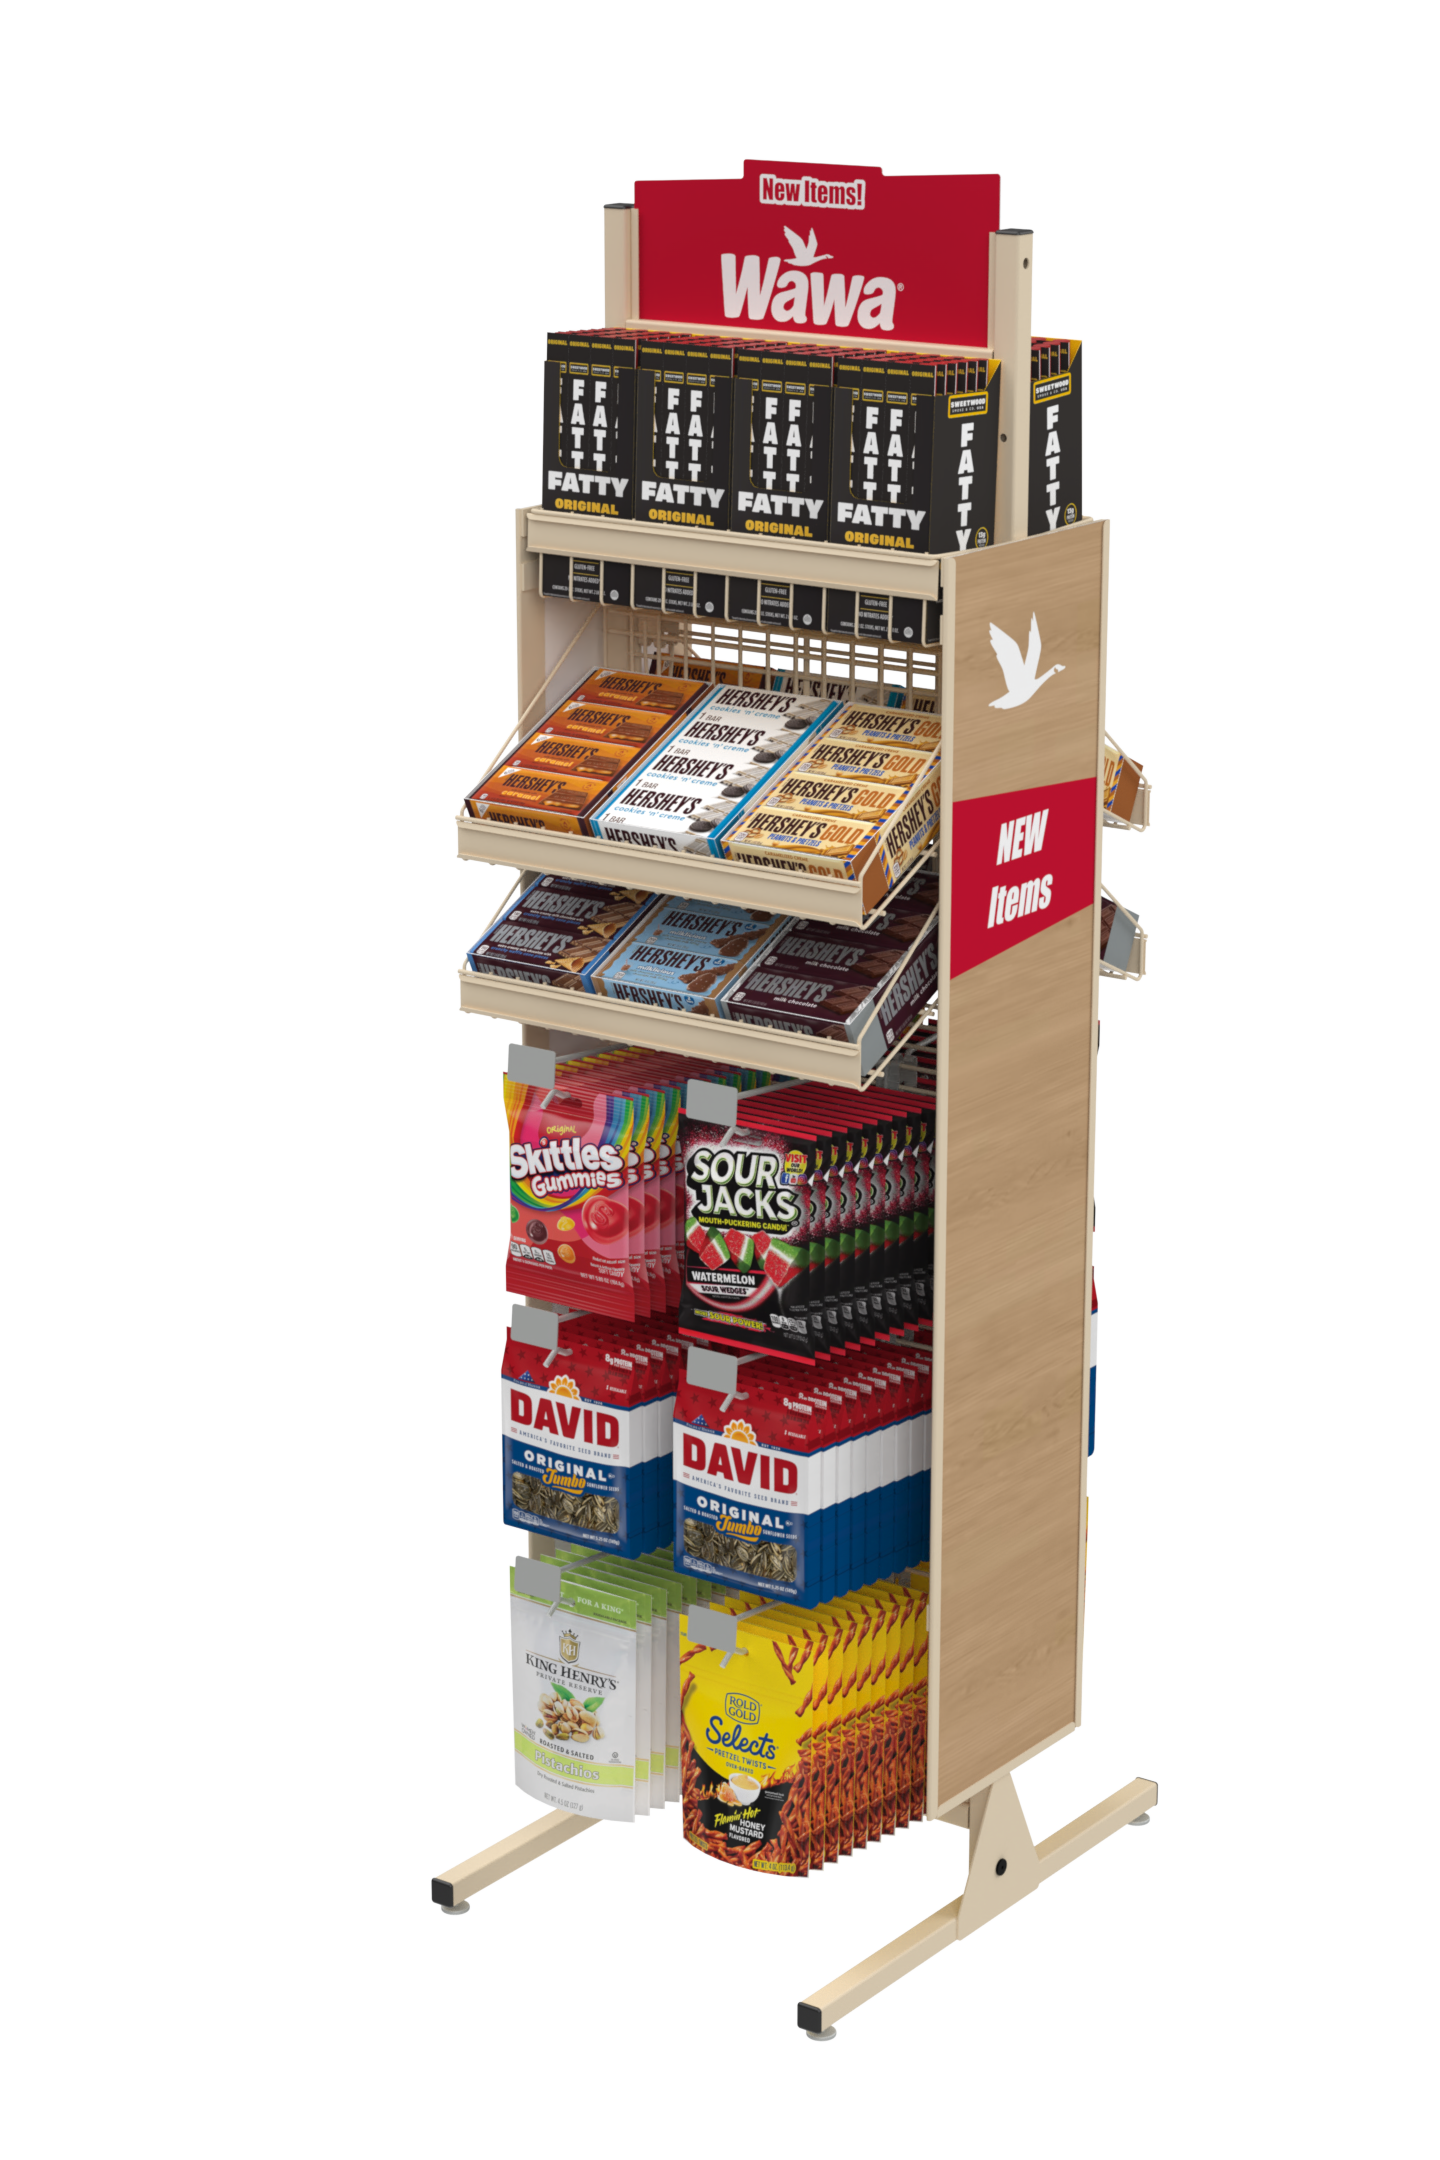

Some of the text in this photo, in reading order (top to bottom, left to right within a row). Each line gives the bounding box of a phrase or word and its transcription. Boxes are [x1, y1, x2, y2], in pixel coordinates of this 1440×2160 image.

[762, 177, 863, 206] New Items!
[720, 253, 897, 331] Wawa
[1036, 379, 1069, 394] SWEETWOOD
[951, 398, 986, 408] SWEETWOOD
[1045, 404, 1061, 531] FATTY
[548, 470, 629, 497] FATTY
[956, 422, 974, 551] FATTY
[641, 480, 725, 508] FATTY
[555, 498, 618, 515] ORIGINAL
[737, 491, 824, 520] FATTY
[648, 509, 714, 526] ORIGINAL
[837, 502, 926, 531] FATTY
[745, 519, 812, 538] ORIGINAL
[845, 530, 914, 549] ORIGINAL
[574, 563, 595, 571] GLUTEN-FREE
[668, 575, 689, 583] GLUTEN-FREE
[765, 587, 787, 595] GLUTEN-FREE
[865, 599, 887, 607] GLUTEN-FREE
[599, 676, 662, 694] HERSHEY'S
[598, 691, 637, 702] caramel
[716, 688, 796, 713] HERSHEY'S
[567, 708, 631, 727] HERSHEY'S
[699, 712, 722, 722] 1 BAR
[710, 704, 780, 720] cookies creme
[566, 723, 605, 735] caramel
[684, 721, 765, 747] HERSHEY'S
[841, 710, 942, 739] HERSHEY'S GOL
[862, 730, 885, 738] PEANUTS
[535, 740, 599, 760] HERSHEY'S
[667, 745, 690, 756] 1 BAR
[679, 738, 750, 753] cookies creme
[534, 756, 574, 768] caramel
[652, 755, 734, 781] HERSHEY'S
[810, 744, 927, 774] HERSHEY'S GOLD
[647, 771, 718, 787] cookies creme
[831, 764, 885, 776] PEANUTS PRETZELS
[502, 773, 566, 792] HERSHEY'S
[641, 782, 658, 790] BAR
[501, 790, 540, 801] caramel
[620, 788, 702, 815] HERSHEY'S
[779, 778, 895, 809] HERSHEY'S GOLD
[614, 805, 685, 822] cookies creme
[799, 798, 853, 811] PEANUTS PRETZELS
[609, 816, 626, 824] BAR
[747, 813, 864, 844] HERSHEY'S GOLD
[887, 790, 933, 858] HERSHEY'S
[767, 833, 822, 847] PEANUTS PRETZELS
[996, 808, 1049, 866] NEW
[522, 890, 605, 919] HERSHEY'S
[987, 873, 1053, 929] Items
[662, 911, 742, 936] HERSHEY'S
[490, 924, 573, 953] HERSHEY'S
[630, 946, 710, 972] HERSHEY'S
[777, 936, 865, 967] HERSHEY'S
[637, 964, 675, 976] milklicious
[805, 960, 849, 972] milk chocolate
[744, 972, 833, 1002] HERSHEY'S
[880, 943, 938, 1026] HERSHEY'S
[613, 983, 682, 1010] HERSHEY'S
[794, 999, 817, 1008] chocolate
[511, 1137, 624, 1179] Skittles
[785, 1153, 808, 1163] VISIT
[691, 1150, 778, 1189] SOUR
[531, 1171, 624, 1197] Gummies
[698, 1184, 799, 1222] JACKS
[699, 1216, 761, 1229] MOUTH-PUCKERING
[692, 1271, 755, 1285] WATERMELON
[701, 1285, 719, 1293] SOUR
[710, 1312, 764, 1331] SOUR POWER!
[605, 1354, 632, 1368] 8g PROTEIN
[783, 1398, 812, 1412] 8g PROTEIN
[510, 1388, 619, 1448] DAVID
[520, 1430, 547, 1443] AMERICA'S
[550, 1439, 576, 1451] FAVORITE
[594, 1450, 611, 1458] BRAND
[512, 1459, 544, 1474] SALTED ROASTED
[524, 1450, 607, 1482] ORIGINAL
[683, 1432, 798, 1494] DAVID
[542, 1468, 586, 1489] Jumbo
[587, 1482, 608, 1490] SUNFLOWER
[692, 1475, 789, 1506] AMERICA'S FAVORITE SEED BRAND
[683, 1505, 718, 1520] SALTED ROASTED
[697, 1496, 784, 1529] ORIGINAL
[716, 1514, 762, 1536] Jumbo
[762, 1529, 785, 1538] SUNFLOWER
[577, 1597, 592, 1606] FOR
[601, 1605, 622, 1614] KING
[562, 1642, 576, 1656] KH
[526, 1653, 617, 1691] KING HENRY'S
[536, 1671, 602, 1695] PRIVATE RESERVE
[730, 1696, 757, 1711] ROLD
[729, 1707, 756, 1722] GOLD
[705, 1715, 775, 1759] Selects
[539, 1738, 564, 1753] ROASTED
[571, 1750, 594, 1760] SALTED
[714, 1748, 766, 1769] PRETZEL TWISTS
[535, 1750, 599, 1780] Pistachios
[726, 1762, 754, 1774] OVEN-BAKED
[544, 1773, 557, 1784] Roasted
[562, 1781, 574, 1790] Salted
[575, 1785, 594, 1793] Pistachios
[564, 1800, 569, 1808] OZ
[570, 1801, 578, 1810] (127
[714, 1807, 761, 1828] Flamin' Hot
[740, 1819, 766, 1831] HONEY
[729, 1824, 764, 1839] MUSTARD
[729, 1833, 750, 1843] FLAVORED
